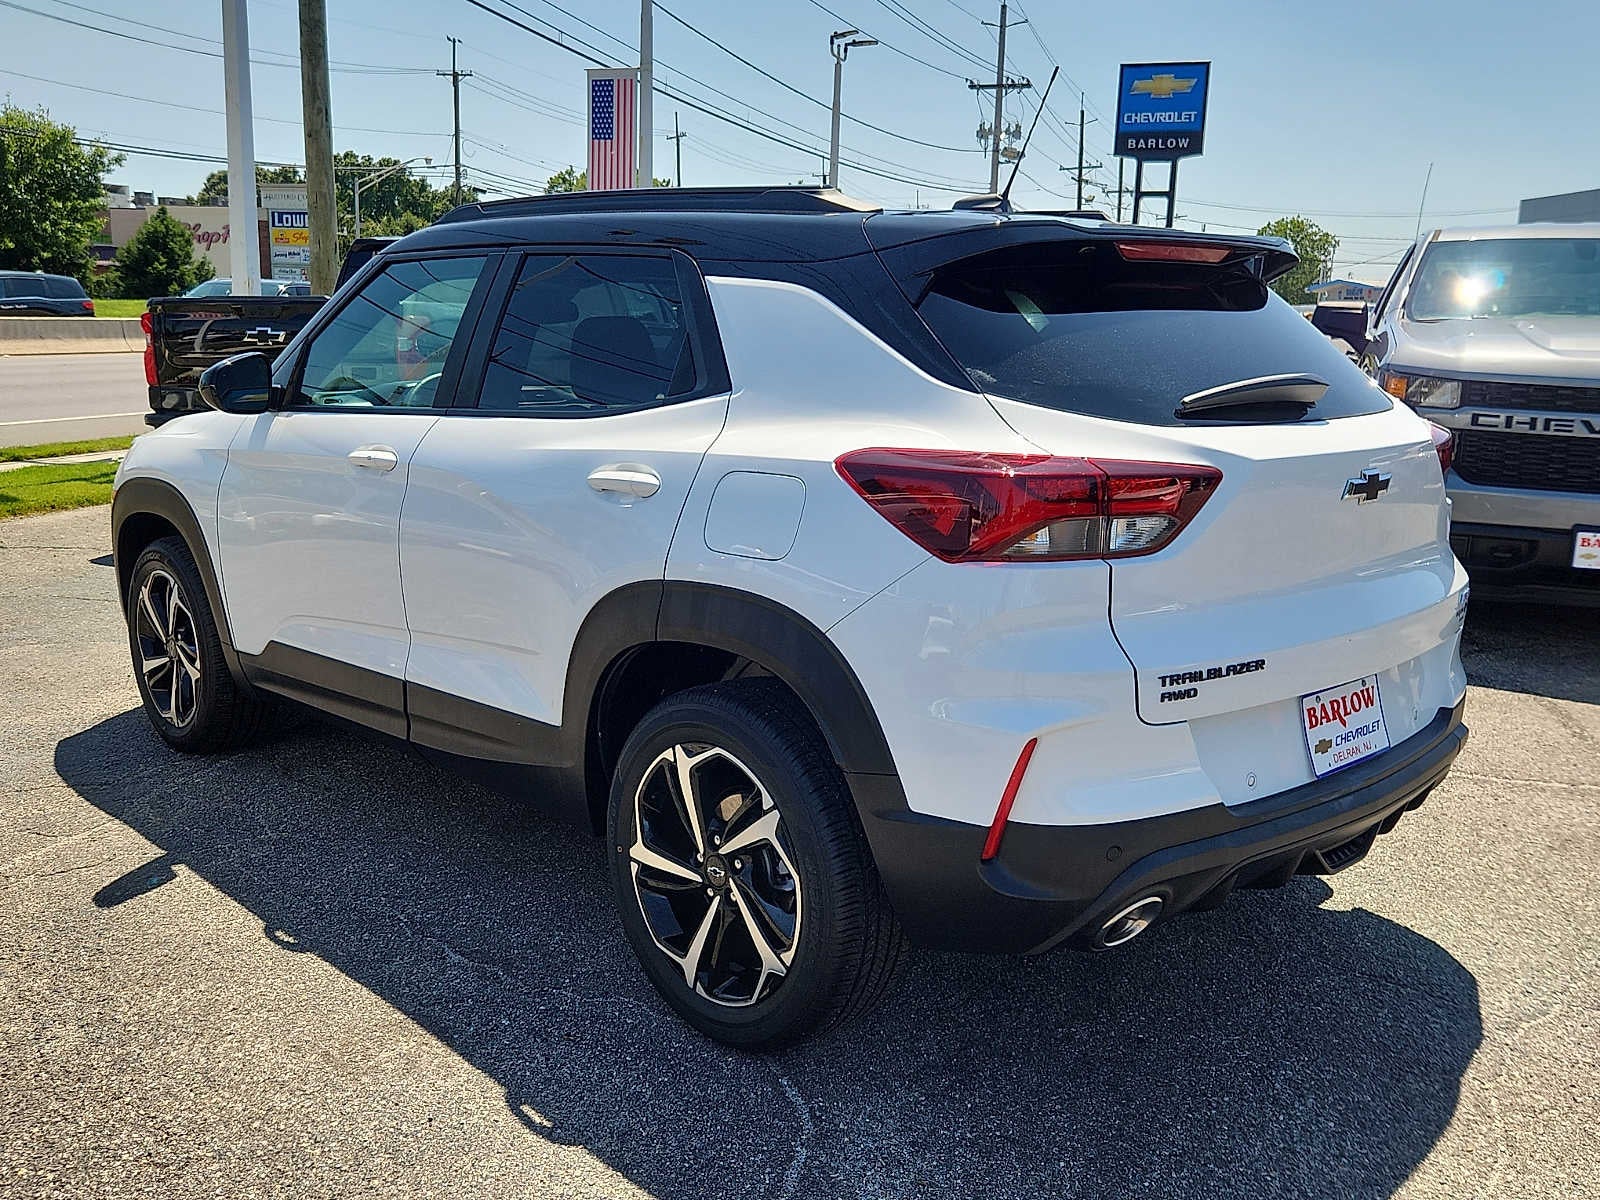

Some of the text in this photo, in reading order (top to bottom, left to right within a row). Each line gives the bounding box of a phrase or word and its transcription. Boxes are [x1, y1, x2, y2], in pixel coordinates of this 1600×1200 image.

[1124, 111, 1198, 124] CHEVROLET
[1128, 138, 1190, 149] BARLOW
[1158, 659, 1266, 688] TRAILBLAZER
[1160, 687, 1199, 703] AWD
[1307, 685, 1375, 730] BARLOW
[1335, 719, 1381, 747] CHEVROLET
[1363, 740, 1372, 752] NJ
